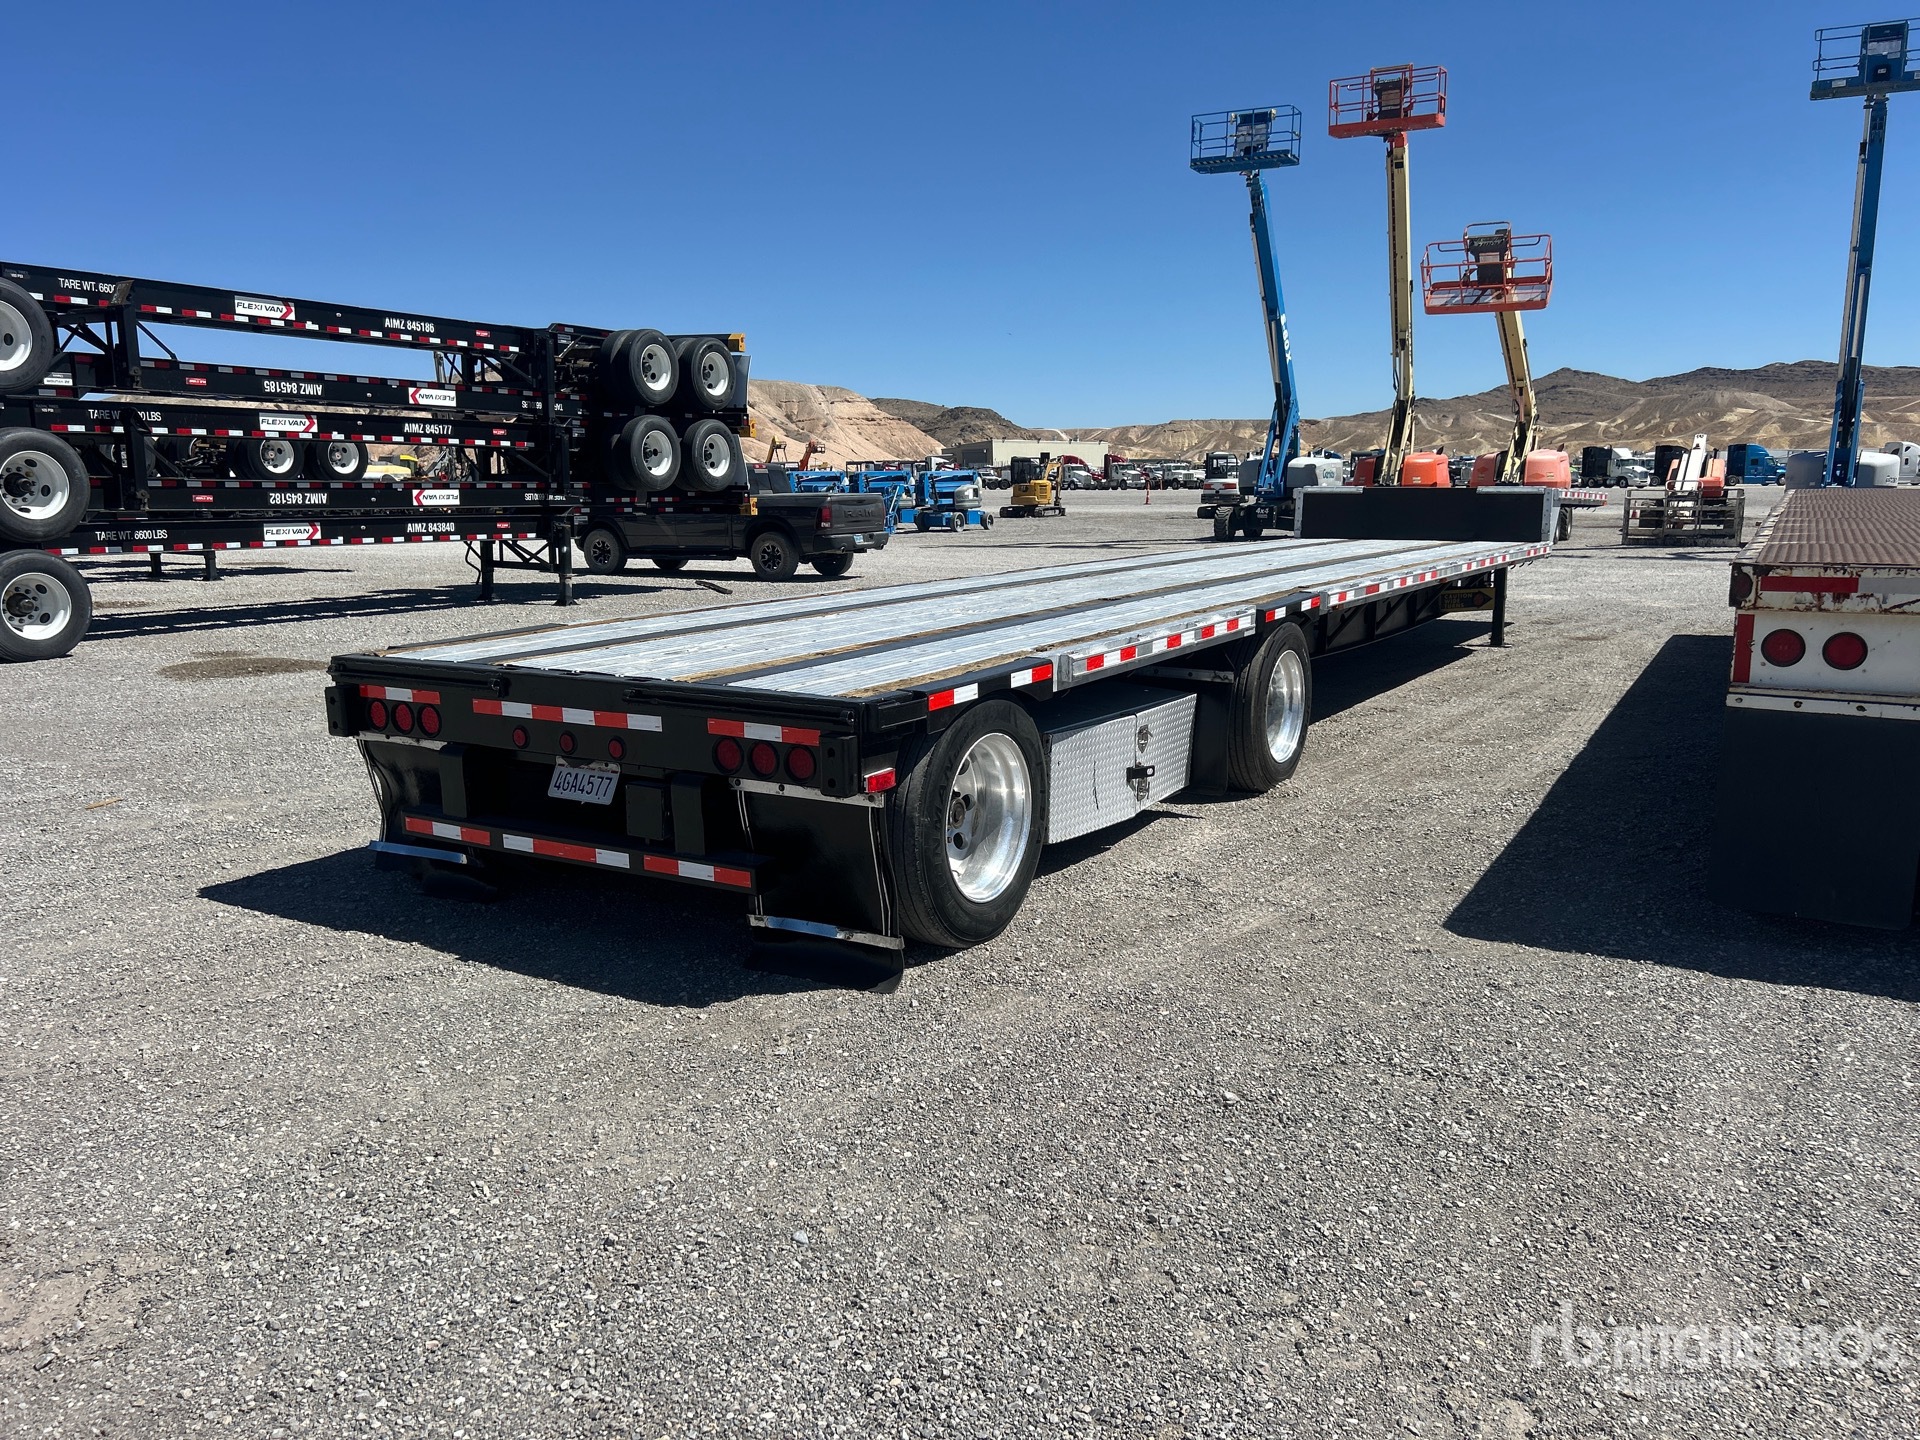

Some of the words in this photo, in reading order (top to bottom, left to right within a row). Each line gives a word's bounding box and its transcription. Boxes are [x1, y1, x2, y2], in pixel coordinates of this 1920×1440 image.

[58, 278, 81, 290] TARE
[82, 280, 98, 292] WT.
[236, 302, 263, 310] FLEXI
[264, 305, 284, 313] VAN
[385, 317, 406, 330] AIMZ
[406, 320, 435, 333] 845186
[264, 380, 298, 394] 845185
[300, 383, 322, 396] AIMZ
[88, 409, 111, 420] TARE
[146, 411, 162, 422] LBS
[288, 419, 307, 427] VAN
[404, 423, 424, 433] AIMZ
[425, 424, 452, 435] 845177
[269, 492, 302, 504] 845182
[304, 492, 327, 504] AIMZ
[843, 509, 875, 518] RAM
[407, 522, 427, 533] AIMZ
[428, 522, 455, 533] 843840
[95, 531, 117, 541] TARE
[118, 531, 134, 541] WT.
[134, 530, 153, 540] 6600
[153, 529, 168, 539] LBS
[554, 771, 613, 797] 4GA4577
